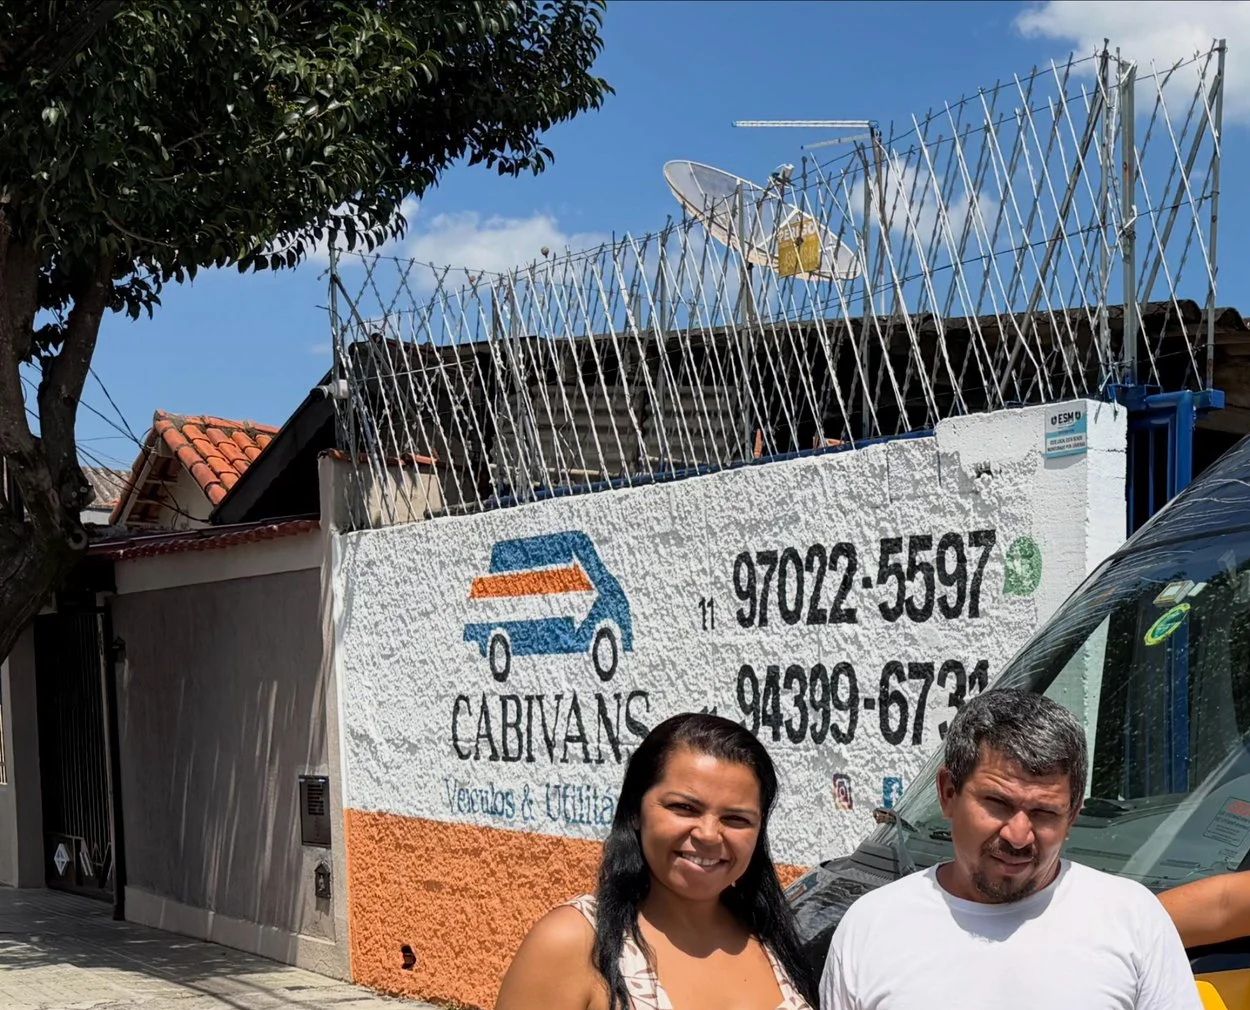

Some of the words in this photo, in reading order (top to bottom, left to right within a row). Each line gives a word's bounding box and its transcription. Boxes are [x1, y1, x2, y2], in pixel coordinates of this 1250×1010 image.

[699, 597, 715, 630] 11
[733, 529, 996, 629] 97022-5597
[451, 689, 650, 765] CABIVANS
[521, 783, 535, 820] &
